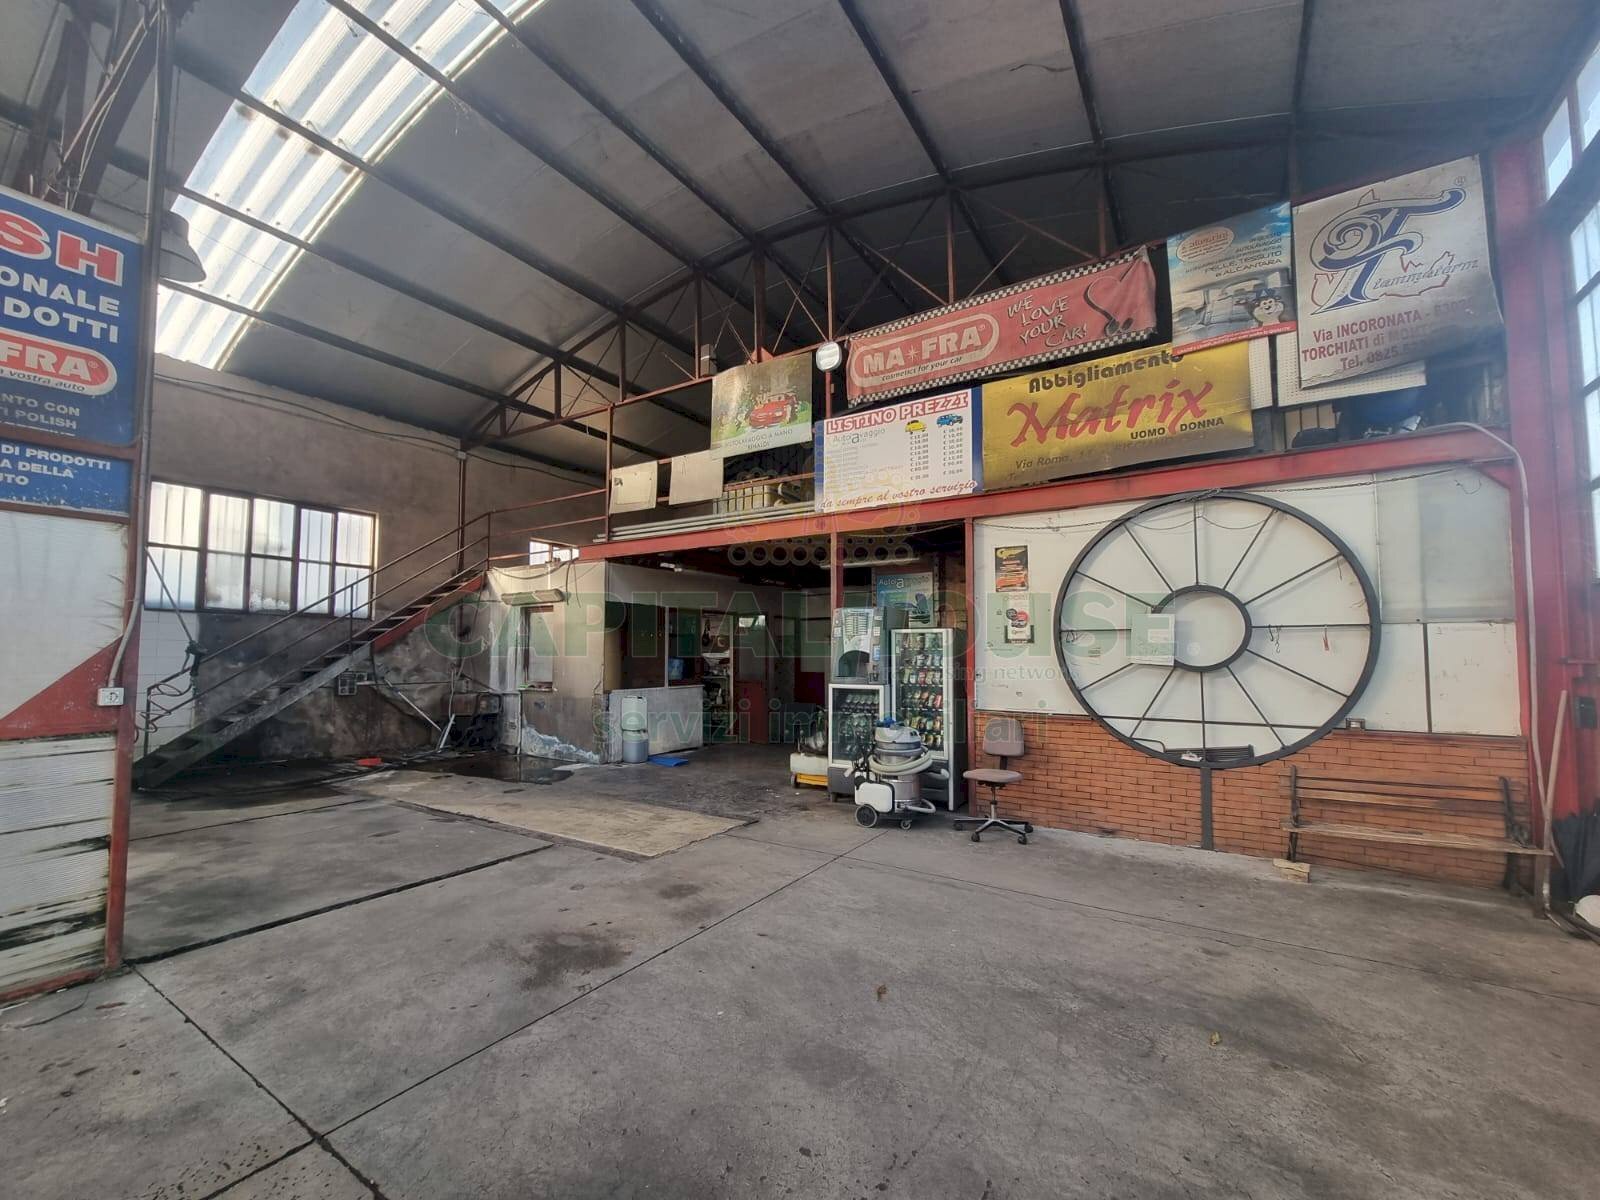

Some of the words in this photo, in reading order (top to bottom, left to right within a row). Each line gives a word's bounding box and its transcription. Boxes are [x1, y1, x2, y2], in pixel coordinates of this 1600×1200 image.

[0, 266, 119, 317] ONALE
[1008, 294, 1033, 318] WE
[4, 296, 118, 343] DOTTI
[1021, 296, 1070, 327] LOVE
[1312, 328, 1334, 344] Via
[1336, 309, 1422, 337] INCORONATA
[1020, 314, 1067, 345] YOUR
[863, 347, 905, 375] MA
[921, 326, 982, 360] FRA
[1302, 336, 1370, 362] TORCHIATI
[1373, 332, 1386, 347] di
[917, 364, 929, 374] for
[930, 360, 949, 371] your
[950, 356, 963, 364] car
[1029, 349, 1185, 394] Abbigliamento
[1340, 355, 1364, 372] Tel.
[9, 371, 51, 384] vostra
[55, 382, 85, 392] auto
[15, 409, 77, 430] POLISH
[44, 402, 80, 417] CON
[826, 408, 896, 435] LISTINO
[900, 392, 969, 420] PREZZI
[1007, 379, 1214, 449] Matrix
[1130, 427, 1166, 440] UOMO
[1179, 417, 1225, 432] DONNA
[1, 444, 20, 456] DI
[25, 448, 111, 470] PRODOTTI
[18, 461, 74, 479] DELLA
[1015, 458, 1033, 470] Via
[820, 497, 832, 509] da
[836, 494, 872, 508] sempre
[876, 490, 889, 501] al
[892, 487, 926, 500] vostro
[929, 479, 977, 494] servizio
